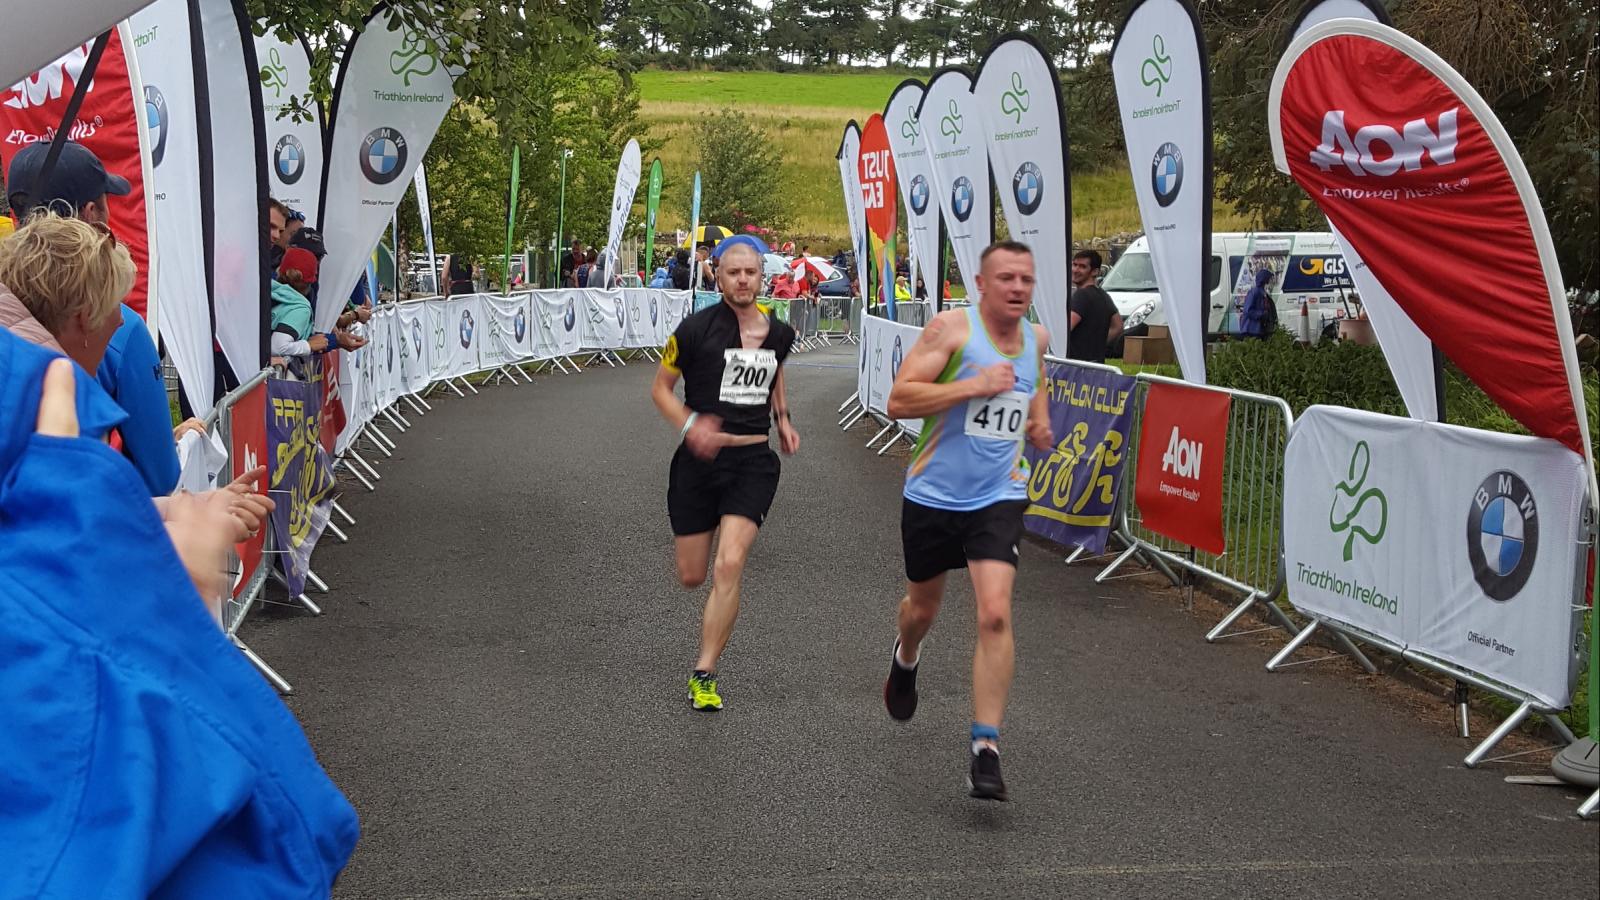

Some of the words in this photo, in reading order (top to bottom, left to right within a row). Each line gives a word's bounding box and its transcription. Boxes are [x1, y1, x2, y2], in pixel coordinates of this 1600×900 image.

[373, 90, 413, 102] Triathlon
[414, 92, 444, 102] Ireland
[366, 128, 406, 148] BMW
[1309, 107, 1459, 177] AON
[1323, 257, 1345, 275] GLS
[732, 365, 768, 388] 200
[1094, 387, 1129, 416] CLUB
[973, 404, 1022, 433] 410
[1162, 426, 1203, 480] AON
[1160, 480, 1183, 496] Empower
[1475, 474, 1537, 520] BMW
[1297, 562, 1352, 598] Triathlon
[1352, 578, 1398, 616] Ireland
[1467, 631, 1491, 649] Official
[1491, 639, 1516, 657] Partner
